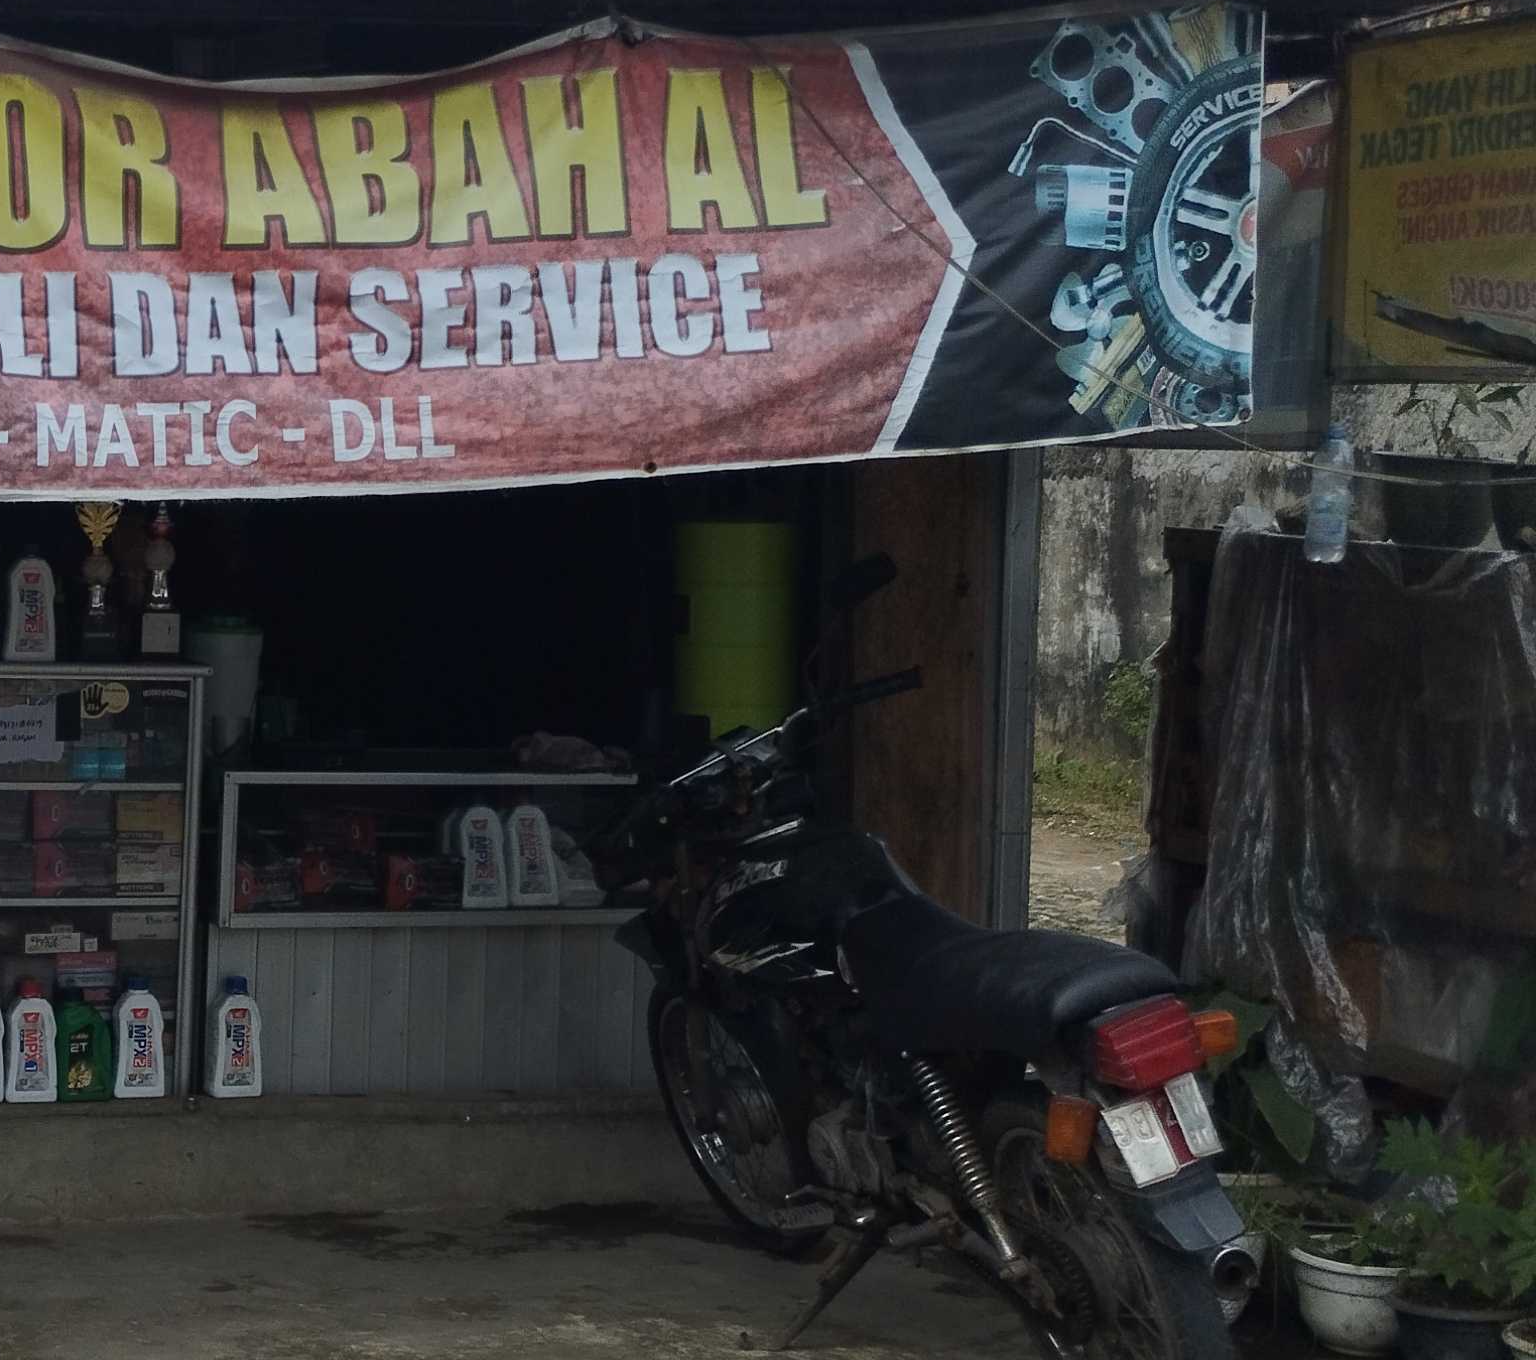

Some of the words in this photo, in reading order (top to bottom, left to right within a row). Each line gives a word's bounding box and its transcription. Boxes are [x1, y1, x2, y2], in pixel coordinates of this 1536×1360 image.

[221, 67, 631, 251] ABAH
[666, 67, 831, 236] AL
[109, 269, 320, 379] DAN
[347, 252, 773, 374] SERVICE
[35, 399, 259, 468] MATIC
[282, 427, 305, 442] -
[328, 395, 456, 464] DLL
[70, 1042, 88, 1053] 2T
[133, 1024, 148, 1068] MPX2
[232, 1024, 246, 1067] MPX2
